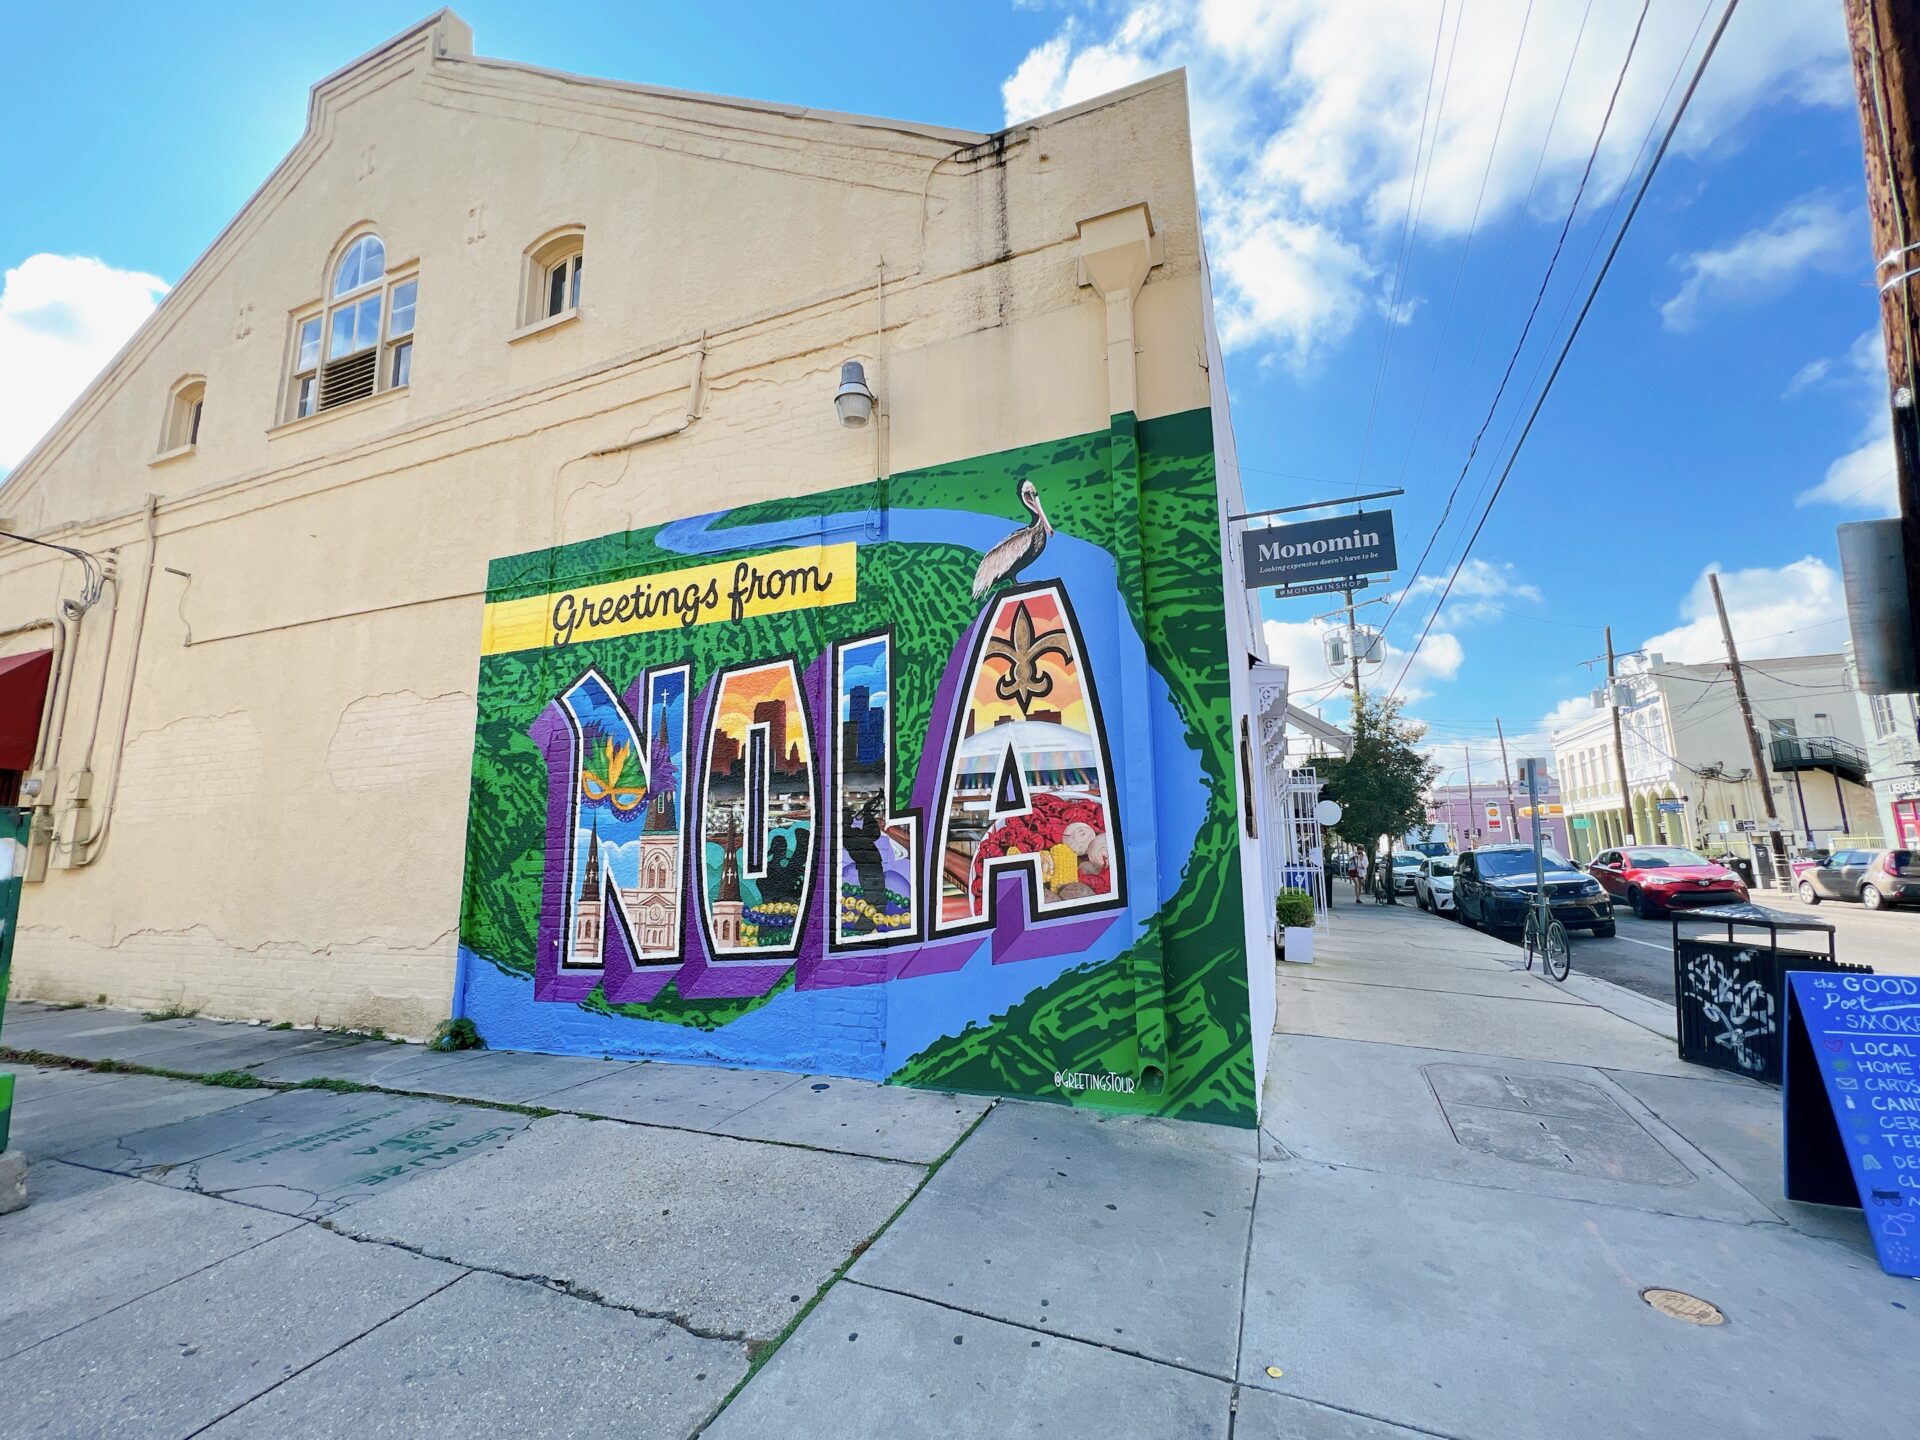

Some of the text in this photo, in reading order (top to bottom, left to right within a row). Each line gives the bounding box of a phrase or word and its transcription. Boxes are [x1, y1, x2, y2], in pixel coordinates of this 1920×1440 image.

[1258, 529, 1380, 562] Monomin
[1259, 565, 1286, 574] Looking
[1286, 561, 1318, 570] expensive
[1319, 555, 1344, 566] doesn't
[1344, 554, 1361, 562] have
[1280, 580, 1362, 595] @MONOMINSHOP
[552, 561, 833, 648] Greetings from
[556, 577, 1129, 970] NOLA
[1813, 976, 1917, 995] the GOOD
[1823, 992, 1872, 1012] Poet
[1850, 1042, 1917, 1057] LOCAL
[1857, 1060, 1915, 1076] HOME
[1864, 1077, 1920, 1094] CARDS
[352, 1121, 456, 1155] NOLA
[359, 1125, 516, 1186] LEGALIZE
[1892, 1154, 1920, 1169] DE
